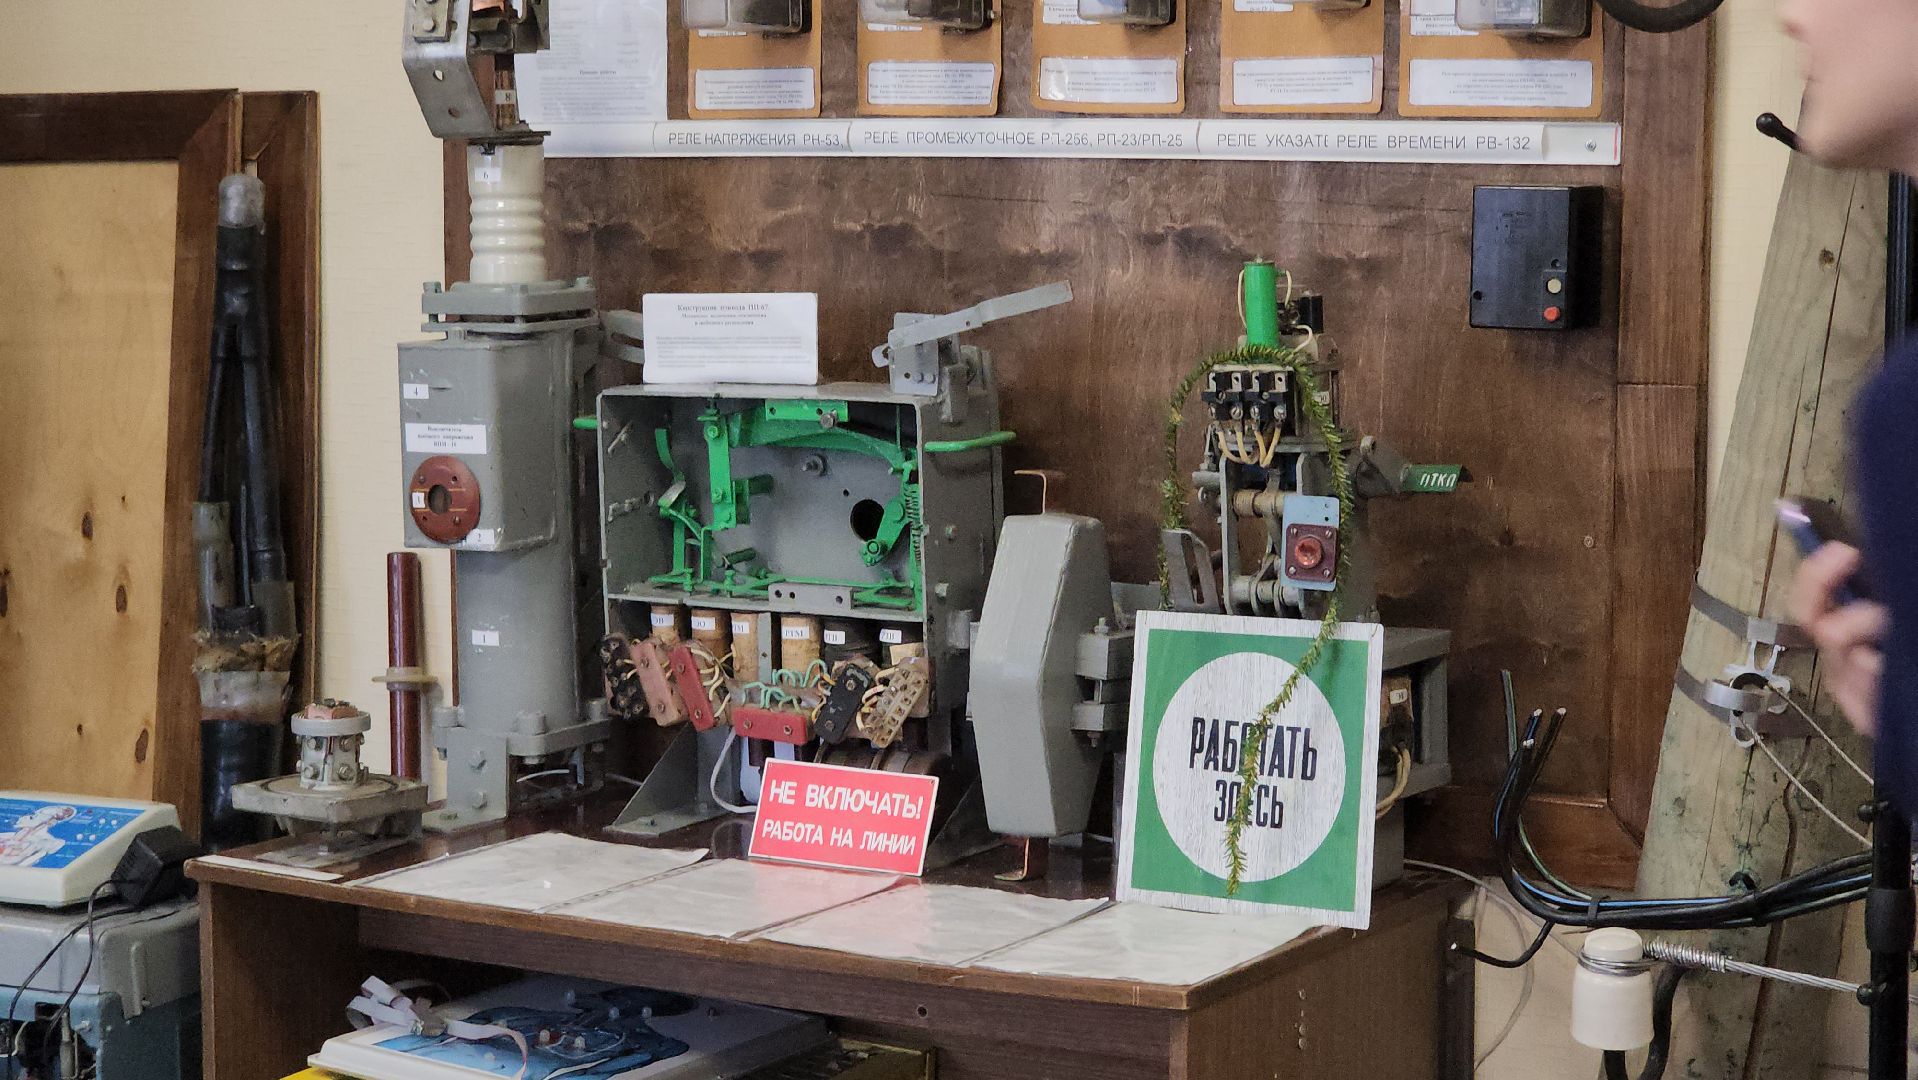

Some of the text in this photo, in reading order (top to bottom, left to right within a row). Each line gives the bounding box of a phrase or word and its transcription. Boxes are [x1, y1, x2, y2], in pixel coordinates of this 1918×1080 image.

[668, 131, 702, 146] РЕЛЕ
[704, 132, 797, 147] НАПРЯЖЕНИЯ
[864, 130, 899, 145] РЕЛЕ
[906, 130, 1036, 147] ПРОМЕЖУТОЧНОЕ
[1097, 131, 1184, 149] РП-23/РП-25
[1217, 133, 1257, 148] РЕЛЕ
[1336, 134, 1531, 150] РЕЛЕ ВРЕМЕНИ РВ-132
[769, 779, 924, 820] НЕ ВКЛЮЧАТЬ!
[1213, 779, 1284, 829] ЗДСЬ
[761, 818, 917, 857] РАБОТА НА ЛИНИИ
